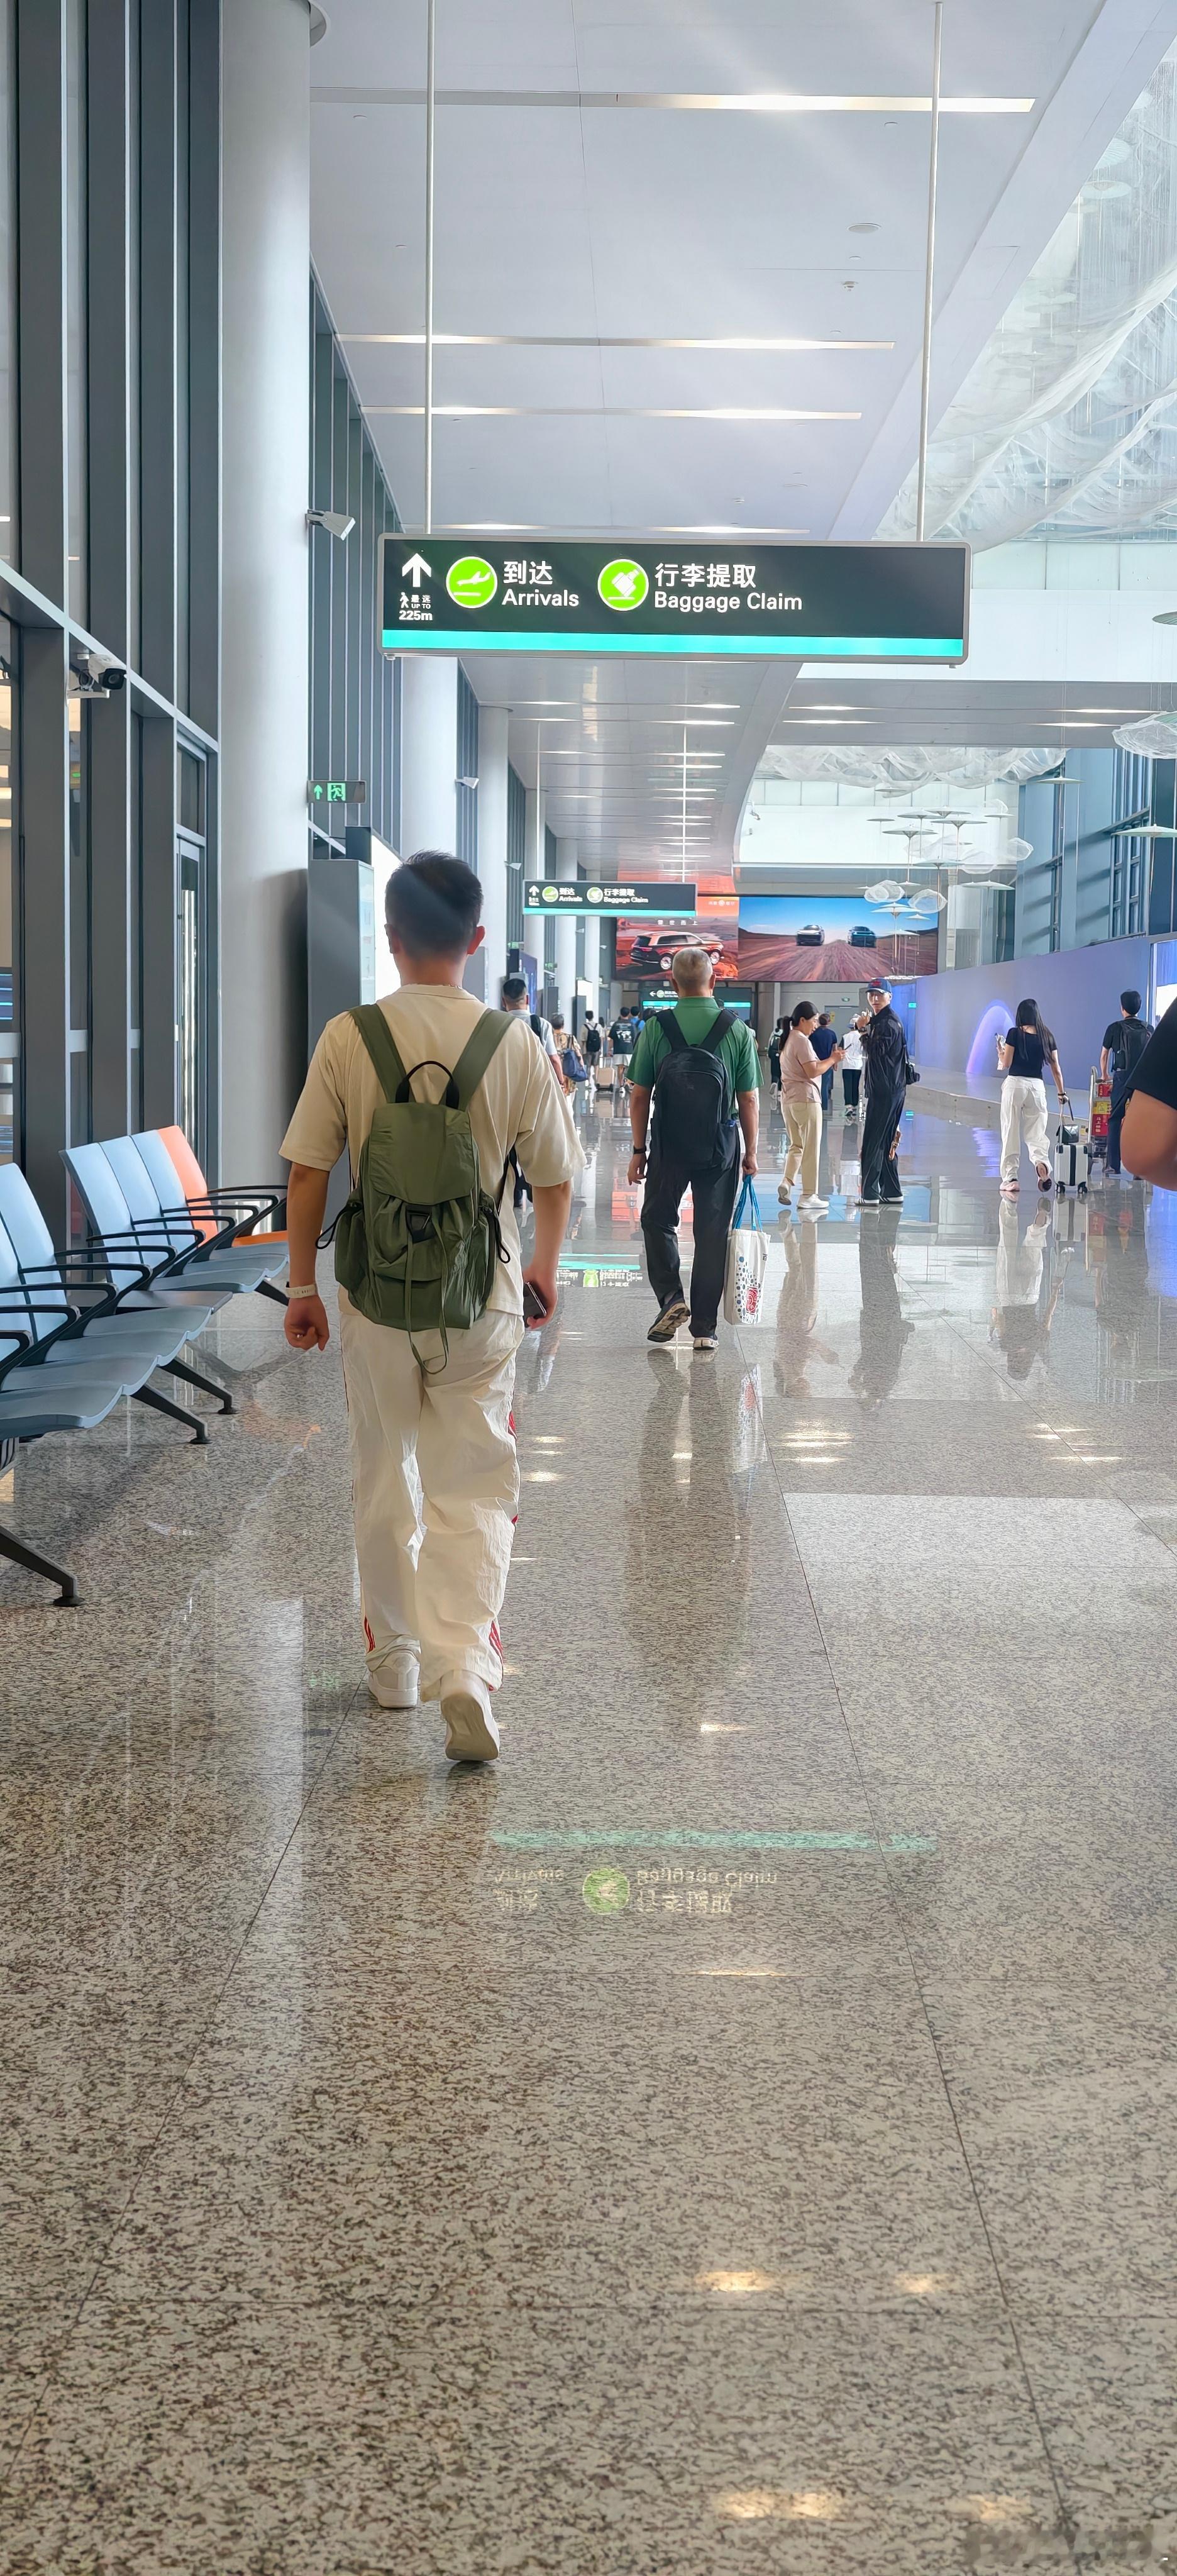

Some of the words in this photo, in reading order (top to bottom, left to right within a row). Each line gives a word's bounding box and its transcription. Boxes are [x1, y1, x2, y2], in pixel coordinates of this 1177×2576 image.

[503, 560, 553, 585] 到达
[655, 563, 756, 588] 行李提取
[502, 589, 579, 607] Arrivals
[655, 591, 740, 613] Baggage
[747, 592, 802, 610] Claim
[399, 610, 433, 621] 225m
